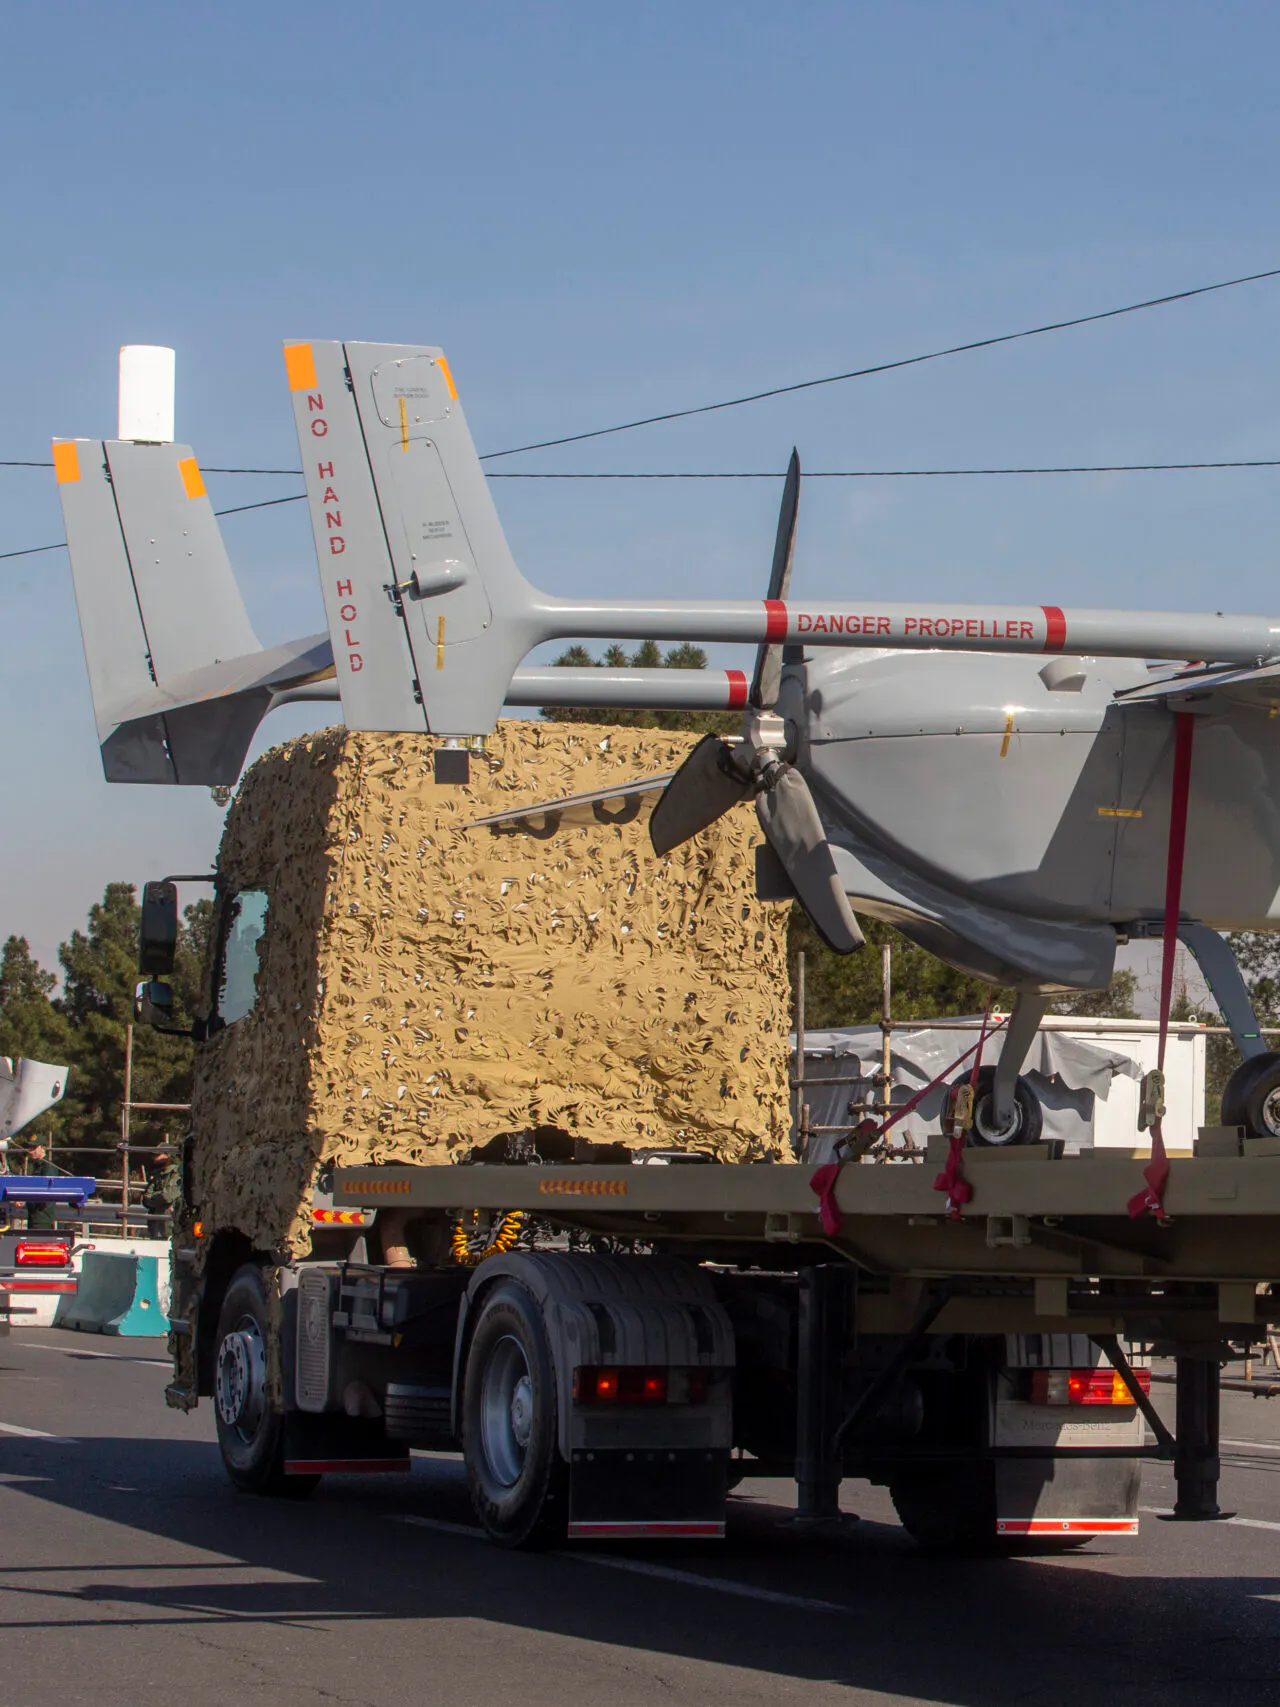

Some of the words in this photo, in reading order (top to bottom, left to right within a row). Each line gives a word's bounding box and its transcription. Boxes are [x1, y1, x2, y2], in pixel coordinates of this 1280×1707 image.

[307, 394, 329, 438] NO
[318, 461, 346, 556] HAND
[336, 579, 364, 673] HOLD
[797, 614, 892, 635] DANGER
[904, 617, 1034, 640] PROPELLER
